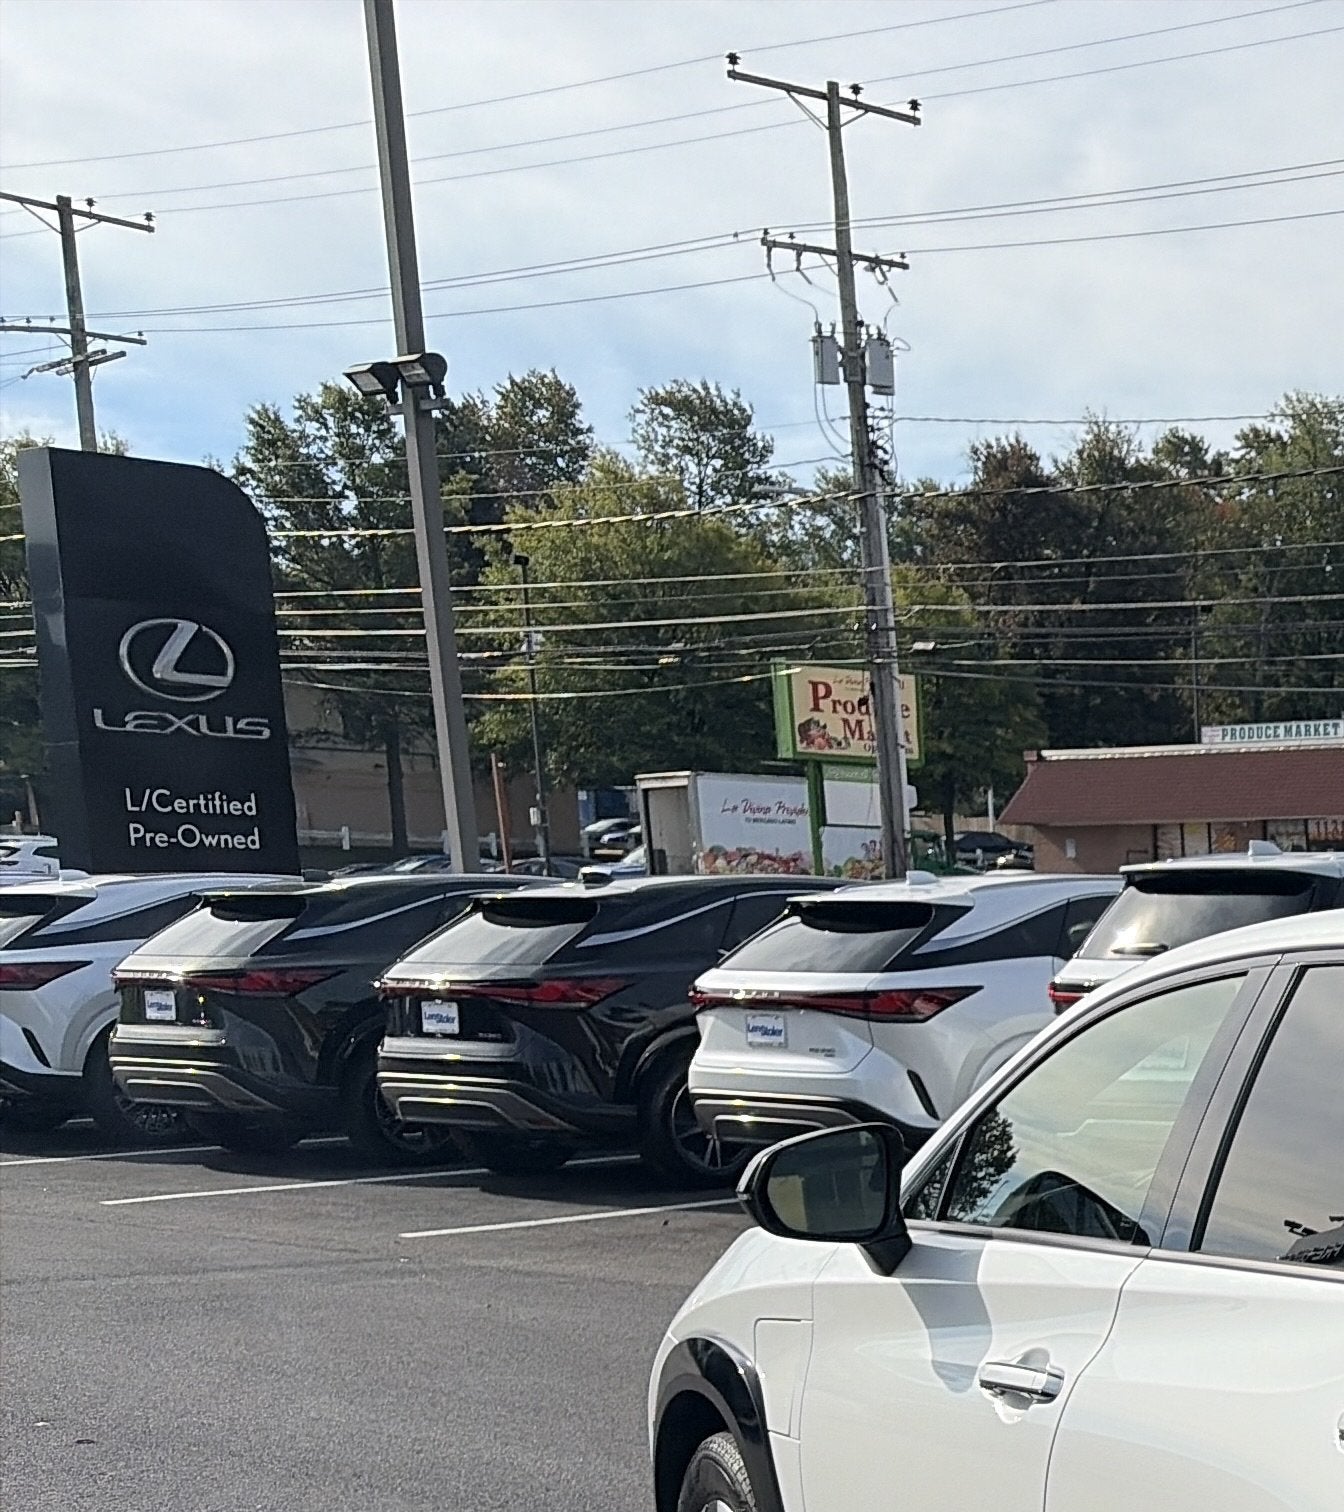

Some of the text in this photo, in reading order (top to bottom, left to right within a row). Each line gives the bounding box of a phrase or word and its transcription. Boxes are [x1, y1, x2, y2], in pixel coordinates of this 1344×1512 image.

[808, 680, 911, 718] Prode
[92, 708, 271, 740] LEXUS
[1221, 725, 1281, 741] PRODUCE
[1284, 722, 1341, 738] MARKET
[124, 787, 258, 817] L/Certified
[128, 824, 260, 850] Pre-Owned
